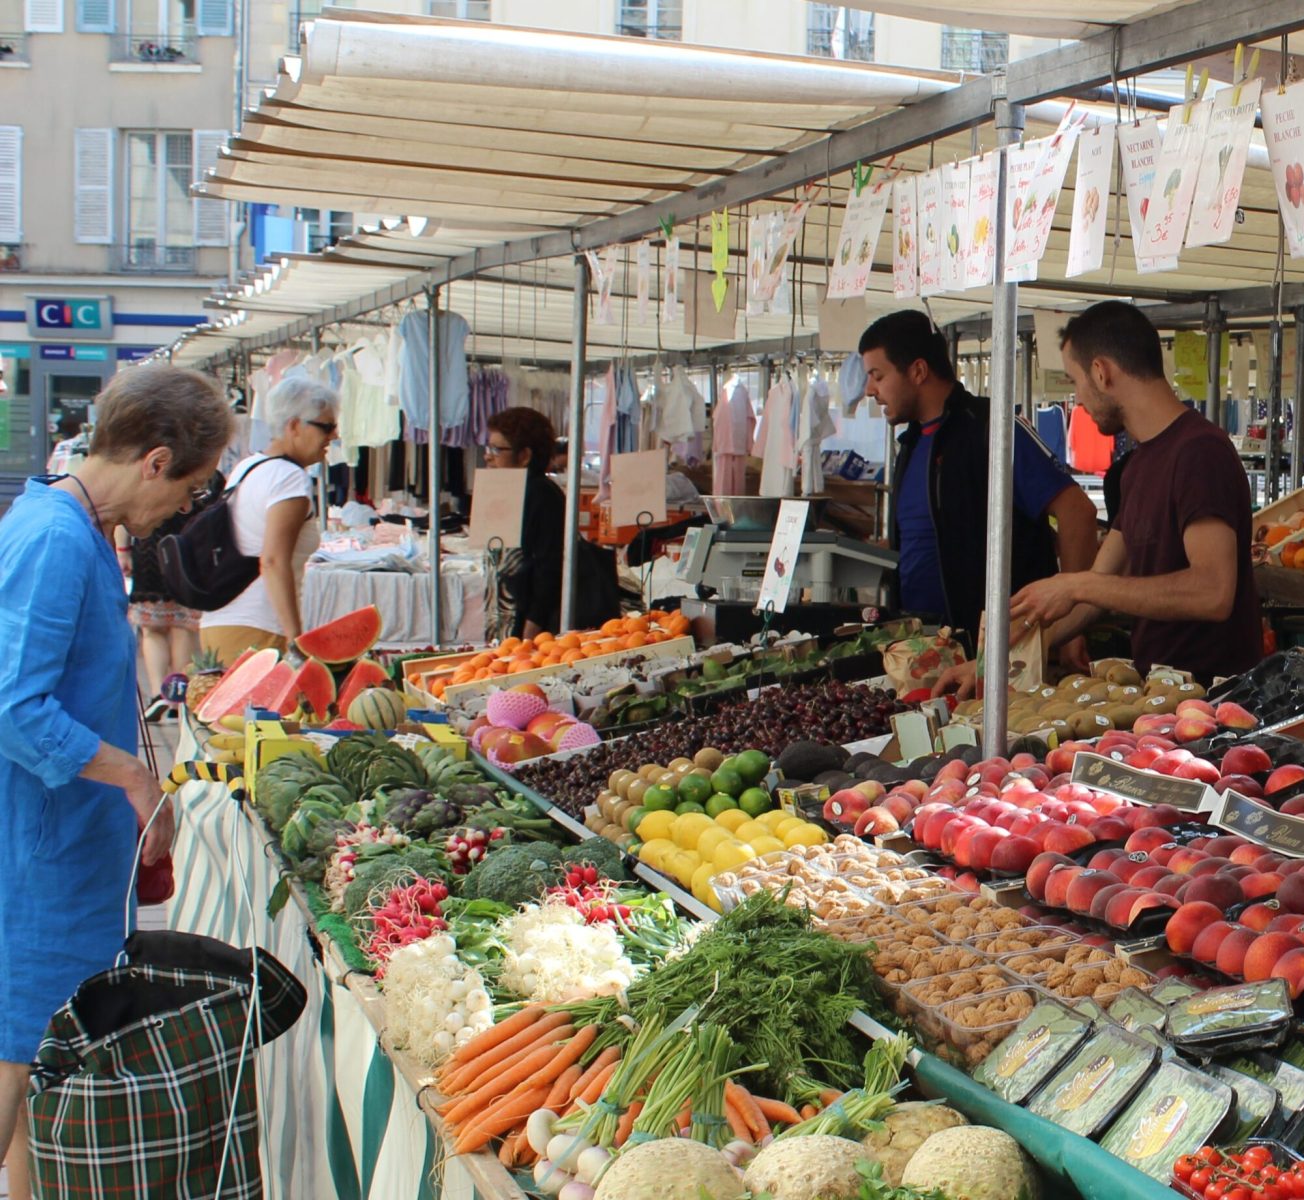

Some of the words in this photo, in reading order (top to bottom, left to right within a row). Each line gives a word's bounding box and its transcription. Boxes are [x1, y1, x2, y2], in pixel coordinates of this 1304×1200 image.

[1275, 109, 1296, 125] PECHE
[1274, 126, 1302, 143] BLANCHE
[1126, 139, 1154, 154] NECTARINE
[1131, 156, 1154, 169] BLANCHE
[41, 304, 95, 325] CIC
